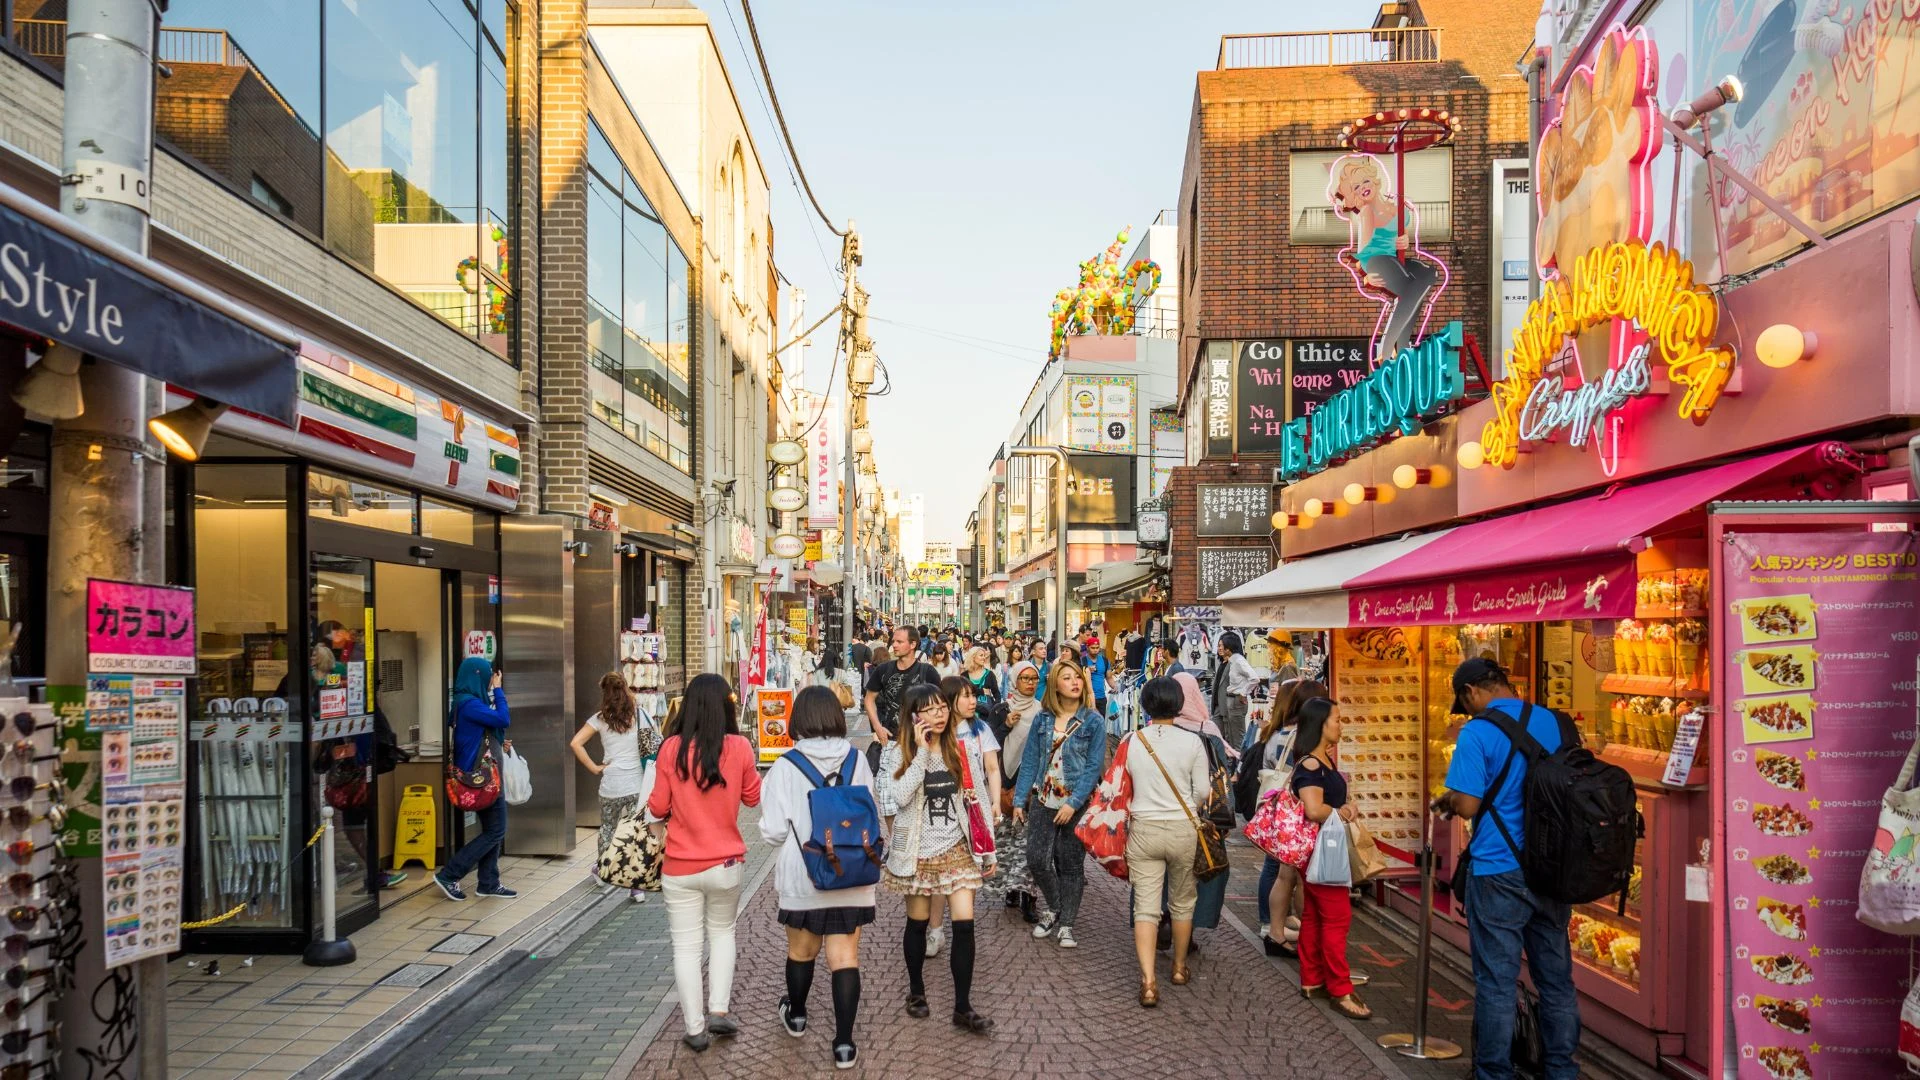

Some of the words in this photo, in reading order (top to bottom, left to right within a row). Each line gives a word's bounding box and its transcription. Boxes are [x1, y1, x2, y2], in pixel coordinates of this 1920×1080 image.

[0, 243, 125, 345] Style
[1209, 359, 1230, 437] 買取委託
[1312, 331, 1453, 466] BURLESQUE
[818, 417, 828, 447] NO
[818, 454, 828, 505] FALL
[1750, 555, 1849, 571] 人気ランキング
[96, 603, 189, 640] カラコン
